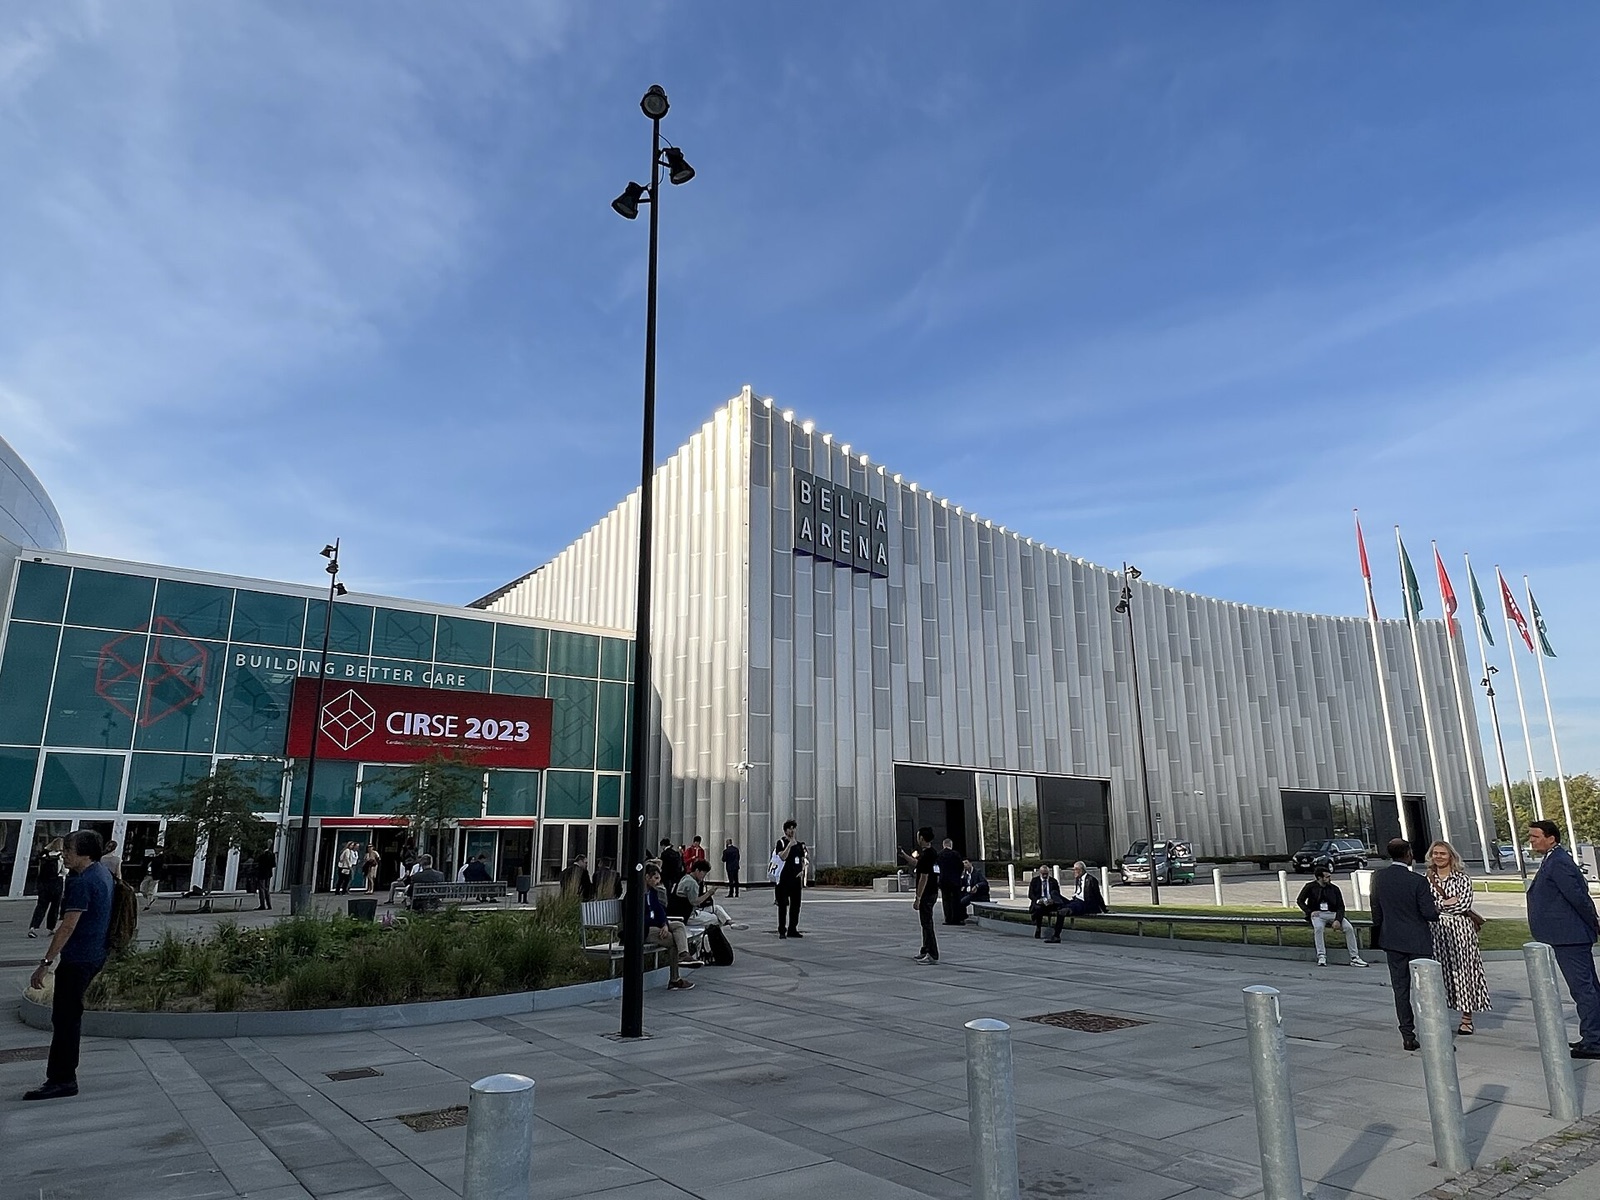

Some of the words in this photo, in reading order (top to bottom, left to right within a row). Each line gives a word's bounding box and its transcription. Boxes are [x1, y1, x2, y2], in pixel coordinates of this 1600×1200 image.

[801, 480, 886, 532] BELLA
[801, 516, 887, 566] ARENA
[235, 653, 335, 675] BUILDING
[345, 664, 413, 682] BETTER
[422, 671, 466, 686] CARE
[386, 711, 459, 738] CIRSE
[464, 717, 530, 742] 2023
